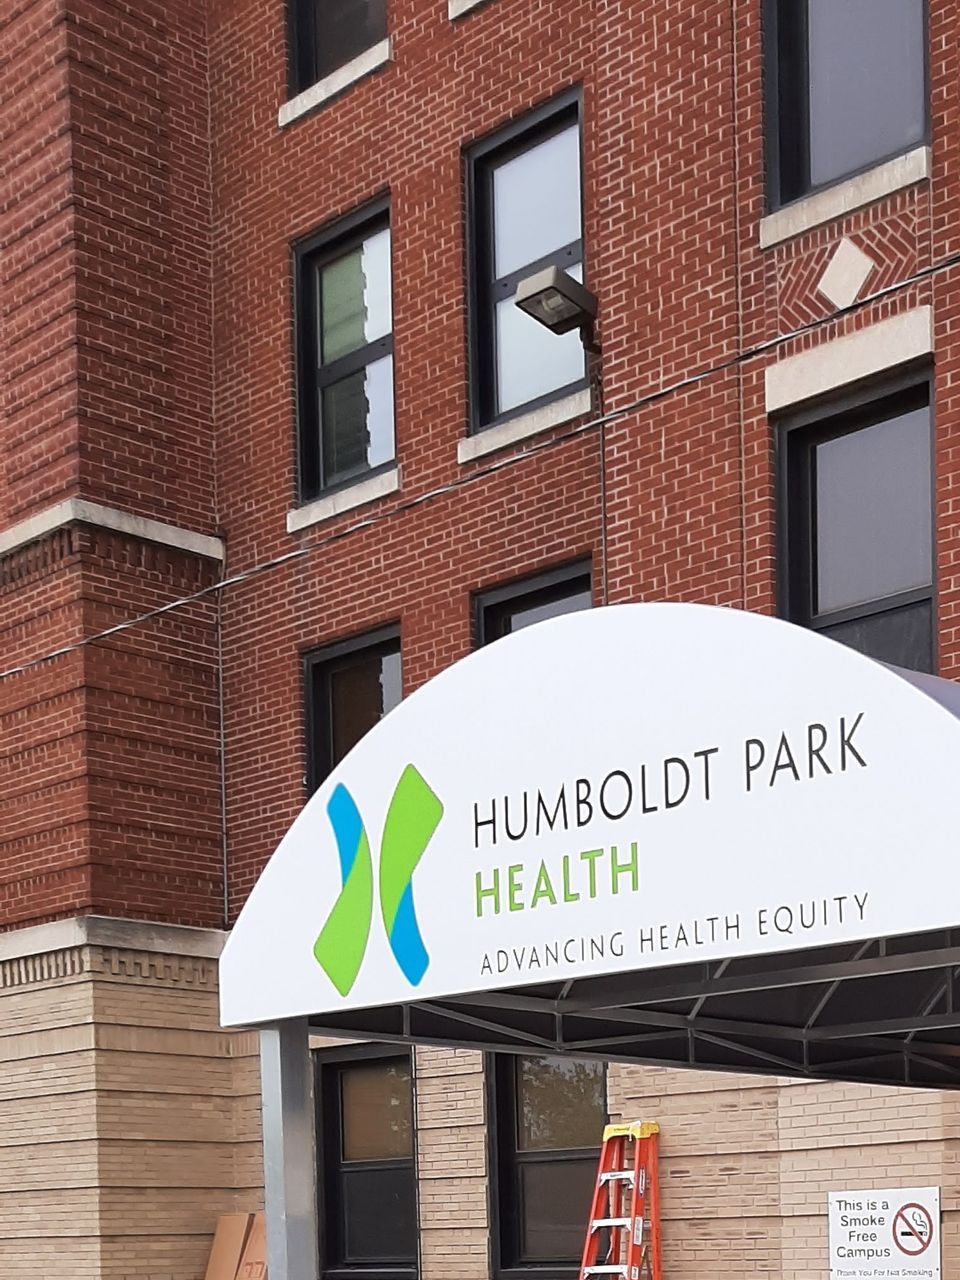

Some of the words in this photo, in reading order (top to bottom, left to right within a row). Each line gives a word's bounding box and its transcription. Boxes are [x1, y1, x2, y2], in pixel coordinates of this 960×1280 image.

[474, 747, 719, 848] HUMBOLDT
[746, 712, 867, 791] PARK
[475, 842, 639, 917] HEALTH
[480, 932, 624, 975] ADVANCING
[640, 913, 741, 953] HEALTH
[758, 892, 869, 935] EQUITY
[836, 1199, 862, 1211] This
[867, 1199, 877, 1210] is
[881, 1201, 890, 1210] a
[840, 1215, 886, 1227] Smoke
[848, 1230, 878, 1242] Free
[836, 1246, 891, 1260] Campus
[902, 1268, 933, 1277] Smoking
